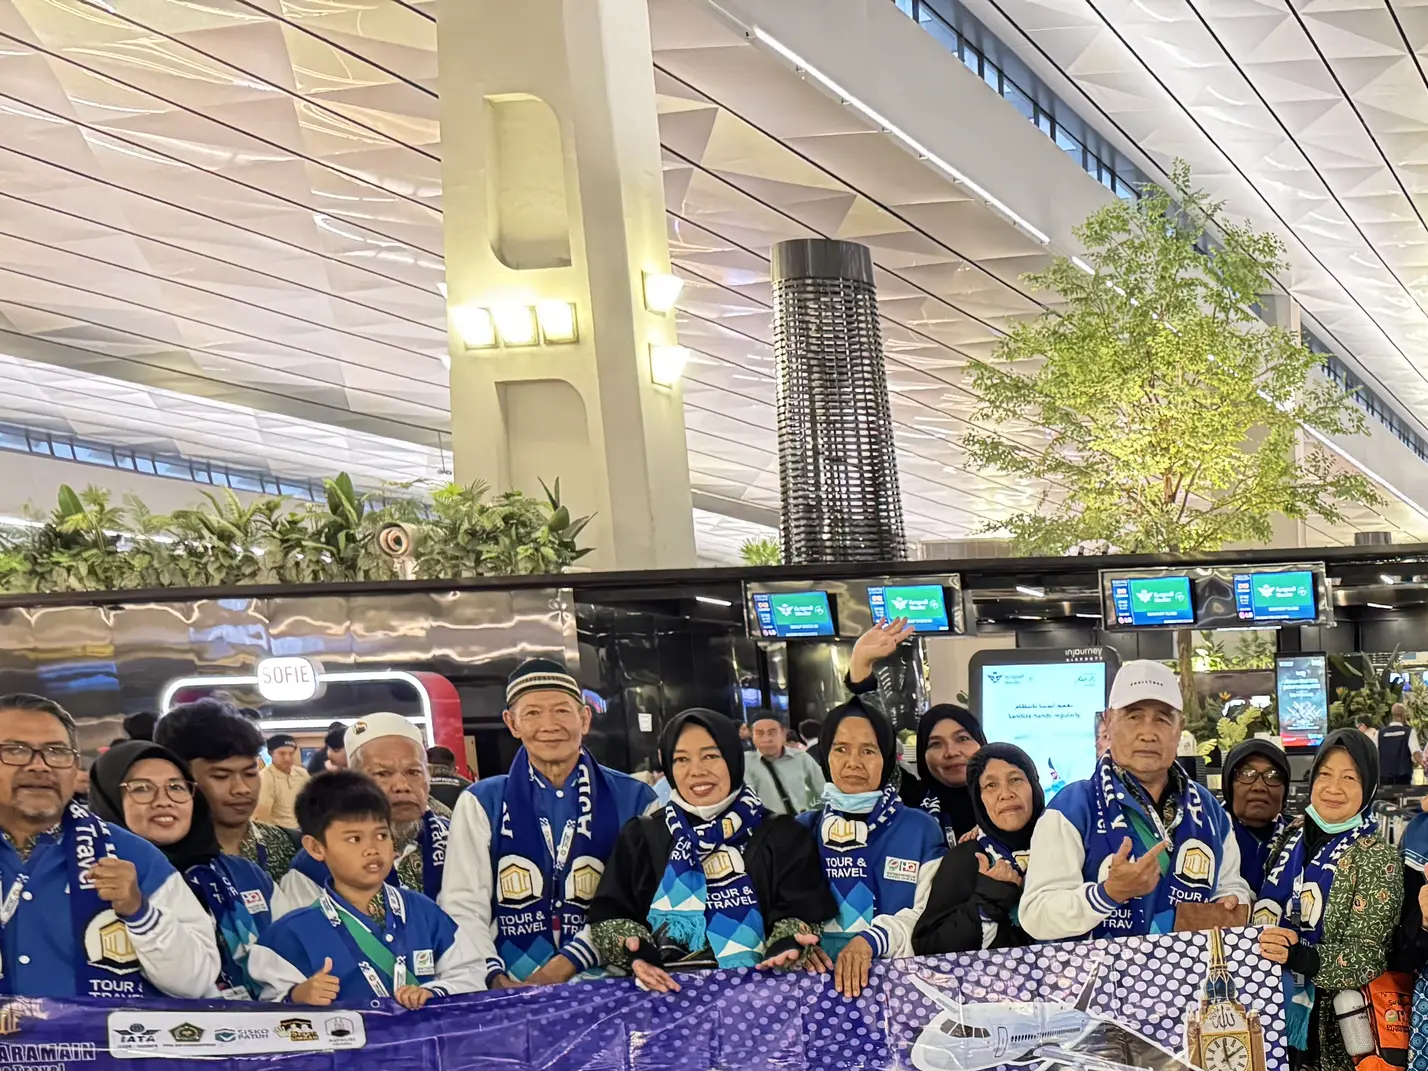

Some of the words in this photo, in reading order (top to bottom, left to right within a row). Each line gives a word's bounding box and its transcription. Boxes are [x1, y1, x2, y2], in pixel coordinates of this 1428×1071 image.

[1065, 648, 1103, 658] injourney
[262, 667, 310, 684] SOFIE
[826, 858, 853, 867] TOUR
[857, 857, 867, 867] &
[826, 868, 867, 878] TRAVEL
[706, 888, 740, 901] TOUR
[743, 886, 753, 896] &
[1170, 886, 1202, 901] TOUR
[706, 895, 757, 910] TRAVEL
[499, 913, 534, 926] TOUR
[536, 910, 546, 921] &
[501, 922, 547, 936] TRAVEL
[88, 980, 134, 992] TOUR
